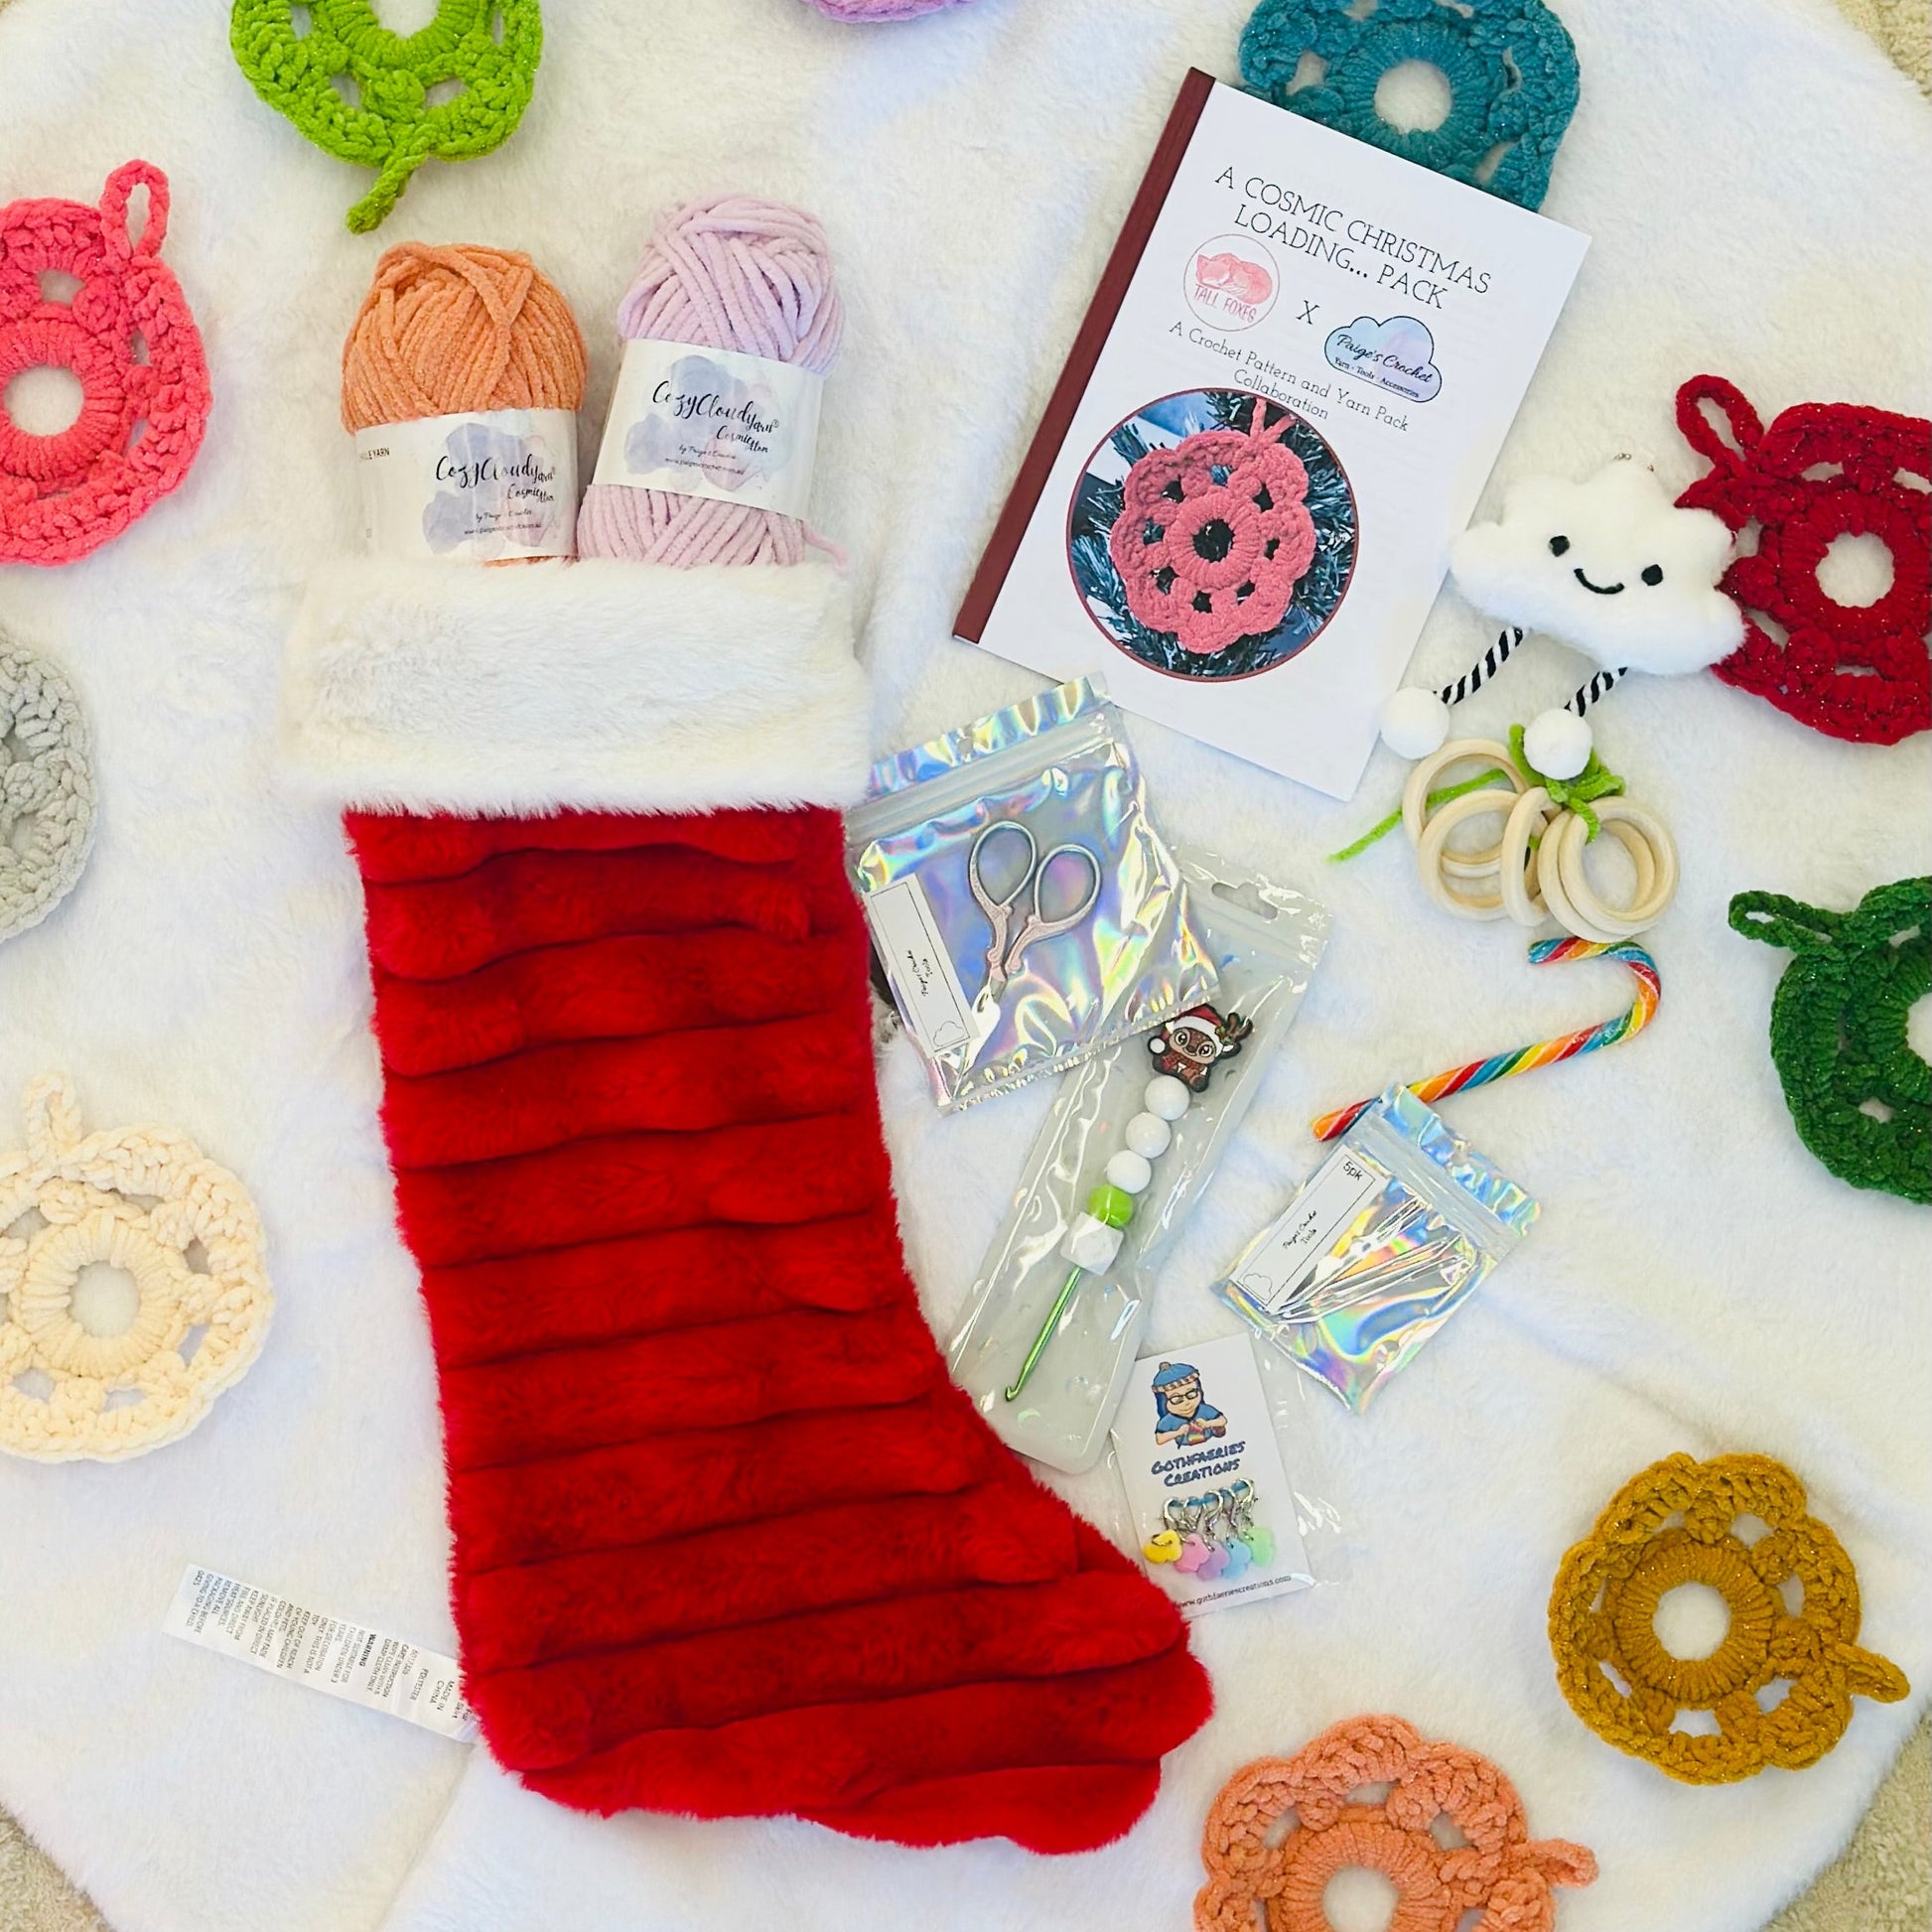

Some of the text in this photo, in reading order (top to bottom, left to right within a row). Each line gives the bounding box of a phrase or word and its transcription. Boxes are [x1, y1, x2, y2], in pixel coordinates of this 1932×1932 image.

[1215, 166, 1491, 294] A COSMIC CHRISTMAS
[1234, 203, 1449, 309] LOADING... PACK
[1193, 283, 1257, 324] TALL FOXES
[1296, 300, 1320, 325] X
[1334, 356, 1350, 369] Yarn
[1356, 365, 1375, 379] Tools
[1336, 334, 1433, 383] Paige's Crochet
[1170, 322, 1410, 433] A Crochet Pattern and Yarn Pack
[1233, 369, 1329, 420] Collaboration
[1342, 1161, 1363, 1181] 5pk
[1151, 1441, 1246, 1476] GOTHFAERIES
[1164, 1458, 1241, 1488] CREATIONS
[359, 1633, 376, 1667] WARNING
[410, 1668, 429, 1702] POLYESTER
[430, 1680, 445, 1705] CHINA
[442, 1681, 455, 1702] MADE
